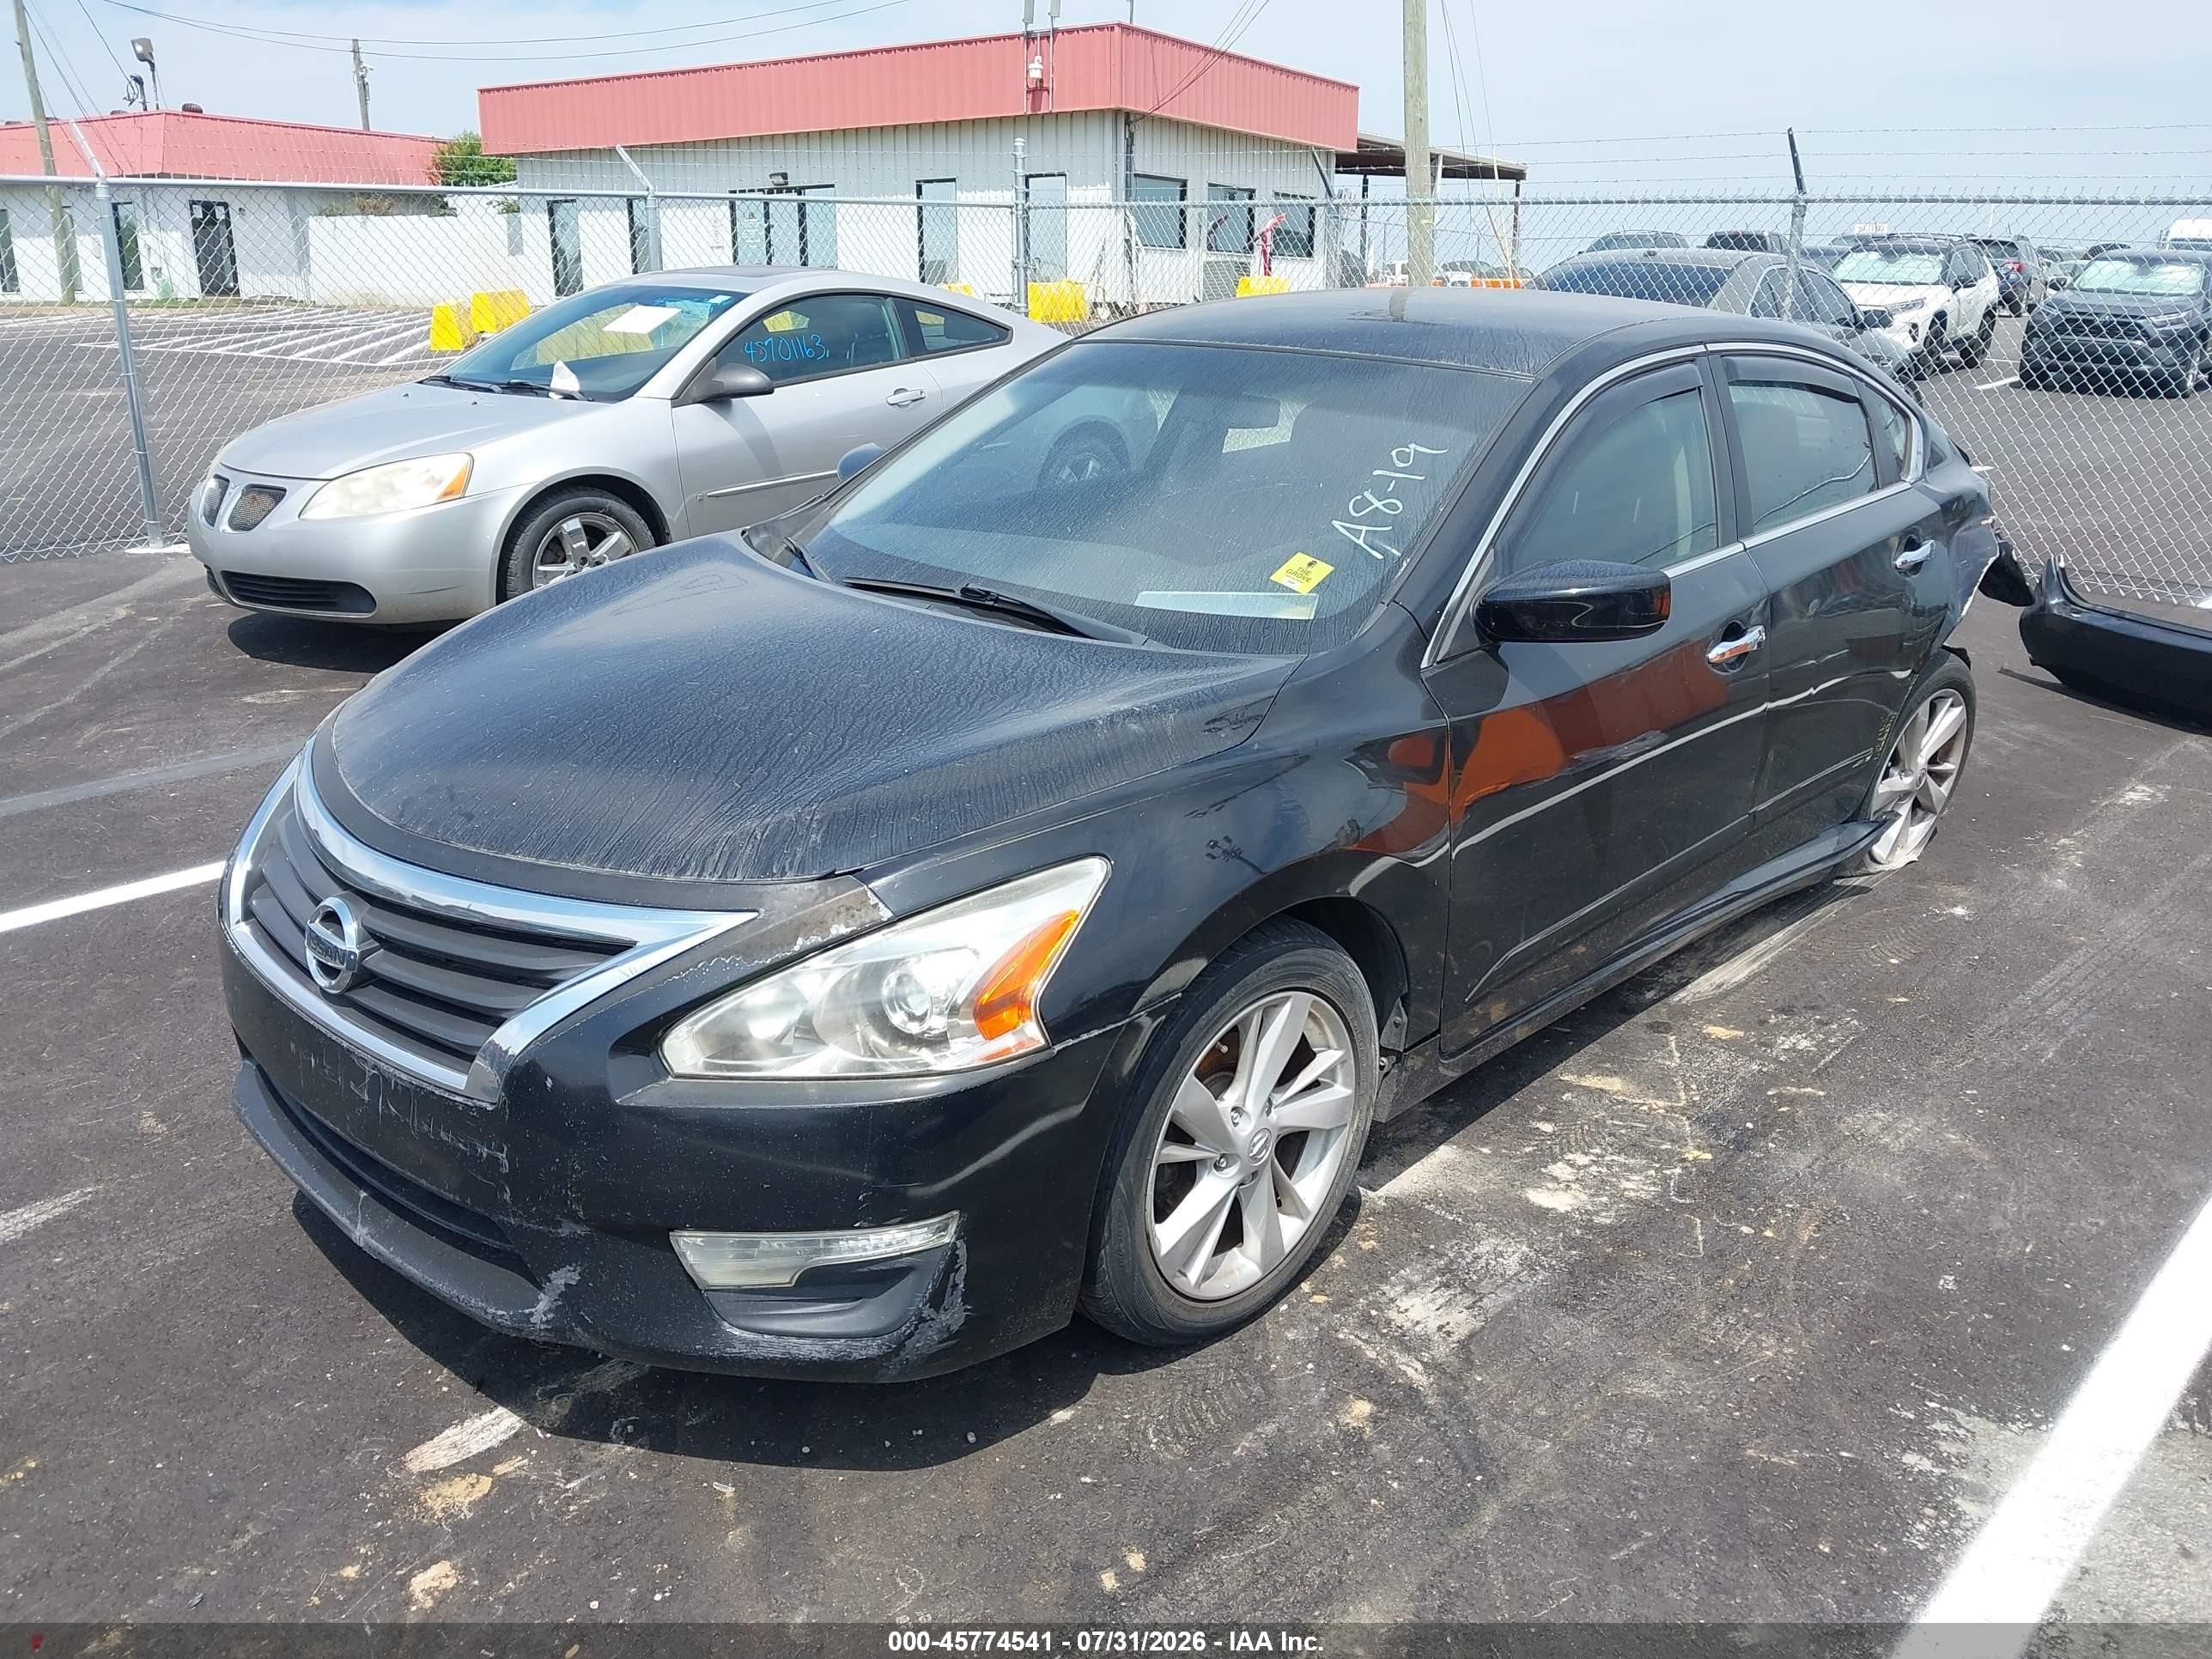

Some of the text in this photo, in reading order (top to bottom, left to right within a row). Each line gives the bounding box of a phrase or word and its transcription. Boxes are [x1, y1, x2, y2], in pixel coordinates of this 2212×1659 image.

[744, 334, 826, 363] 45701163
[1331, 442, 1449, 559] A8-19
[1285, 568, 1313, 583] GROVE
[1297, 567, 1313, 576] THE
